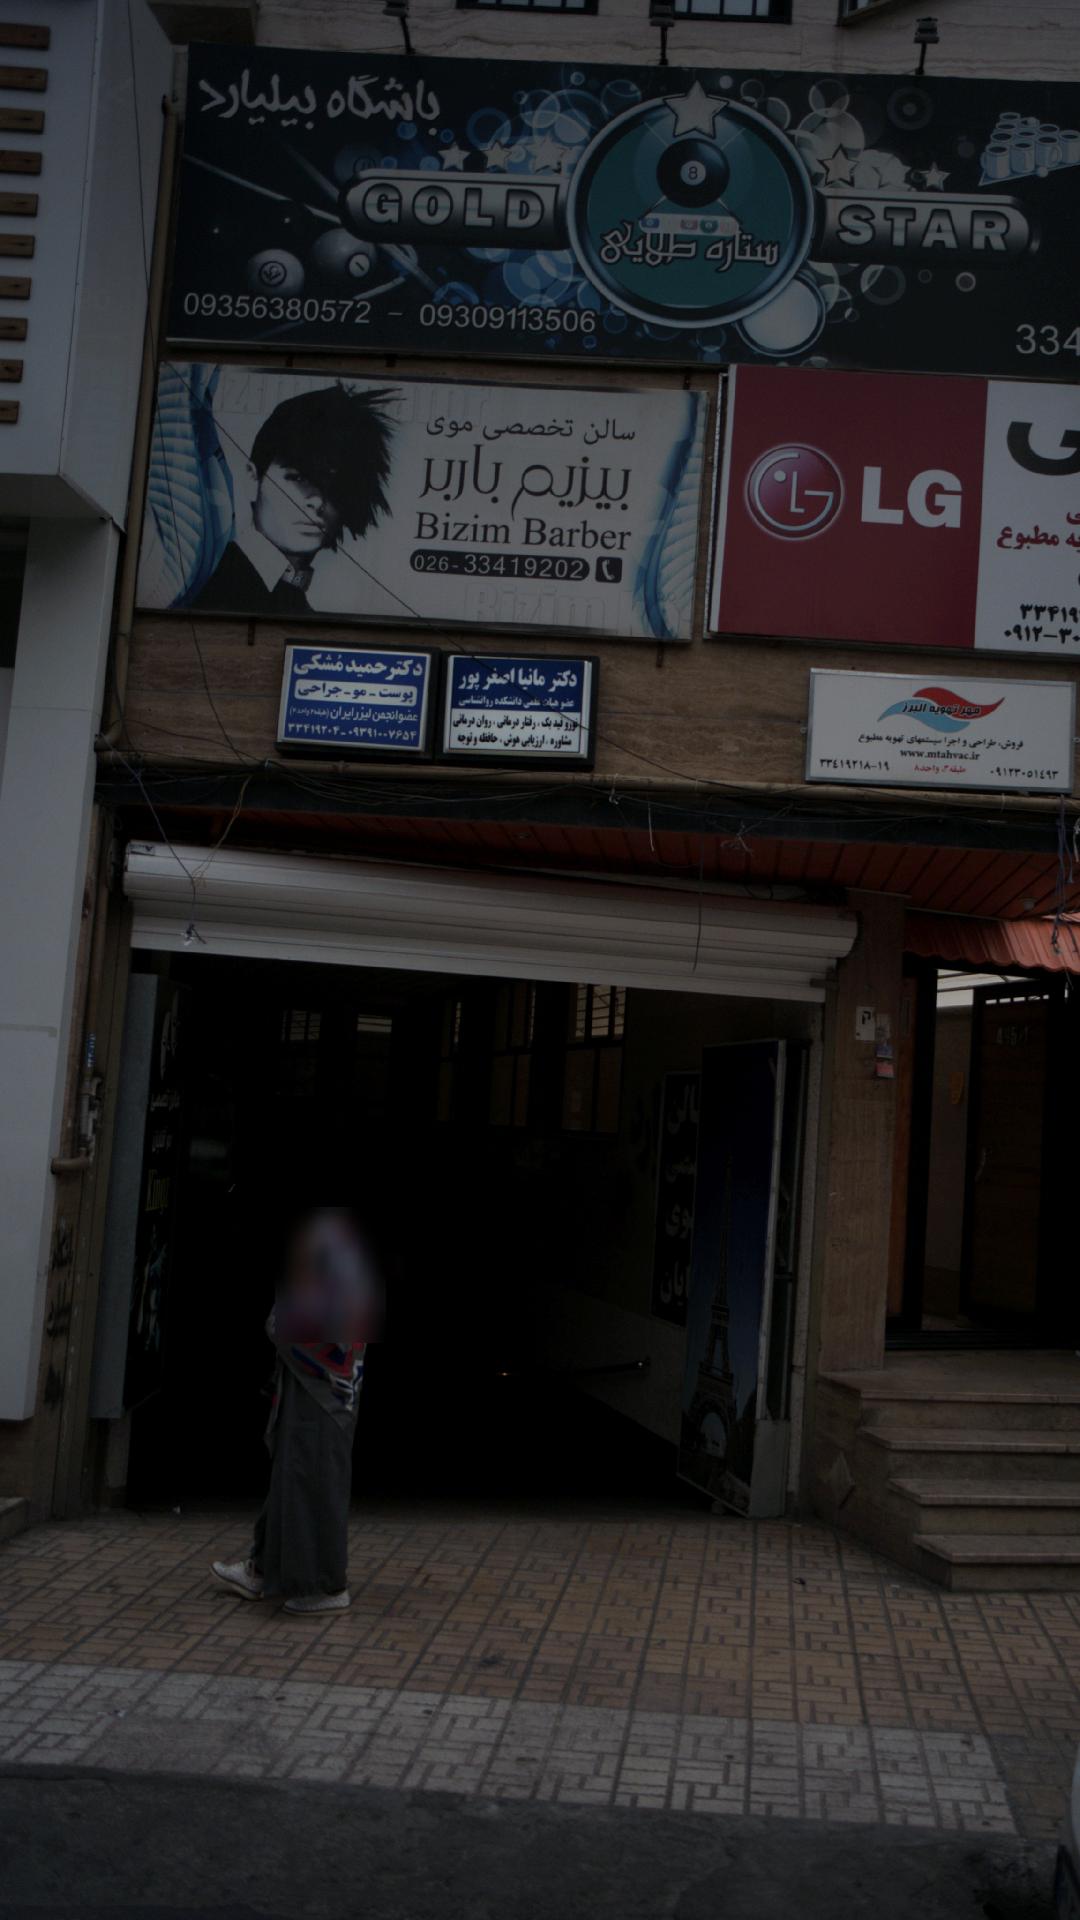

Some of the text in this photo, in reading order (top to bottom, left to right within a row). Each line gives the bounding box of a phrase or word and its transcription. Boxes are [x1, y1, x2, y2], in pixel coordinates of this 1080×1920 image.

[199, 68, 441, 136] باشگاه بیلیارد
[362, 183, 545, 229] GOLD
[836, 204, 1011, 252] STAR
[600, 219, 779, 272] ستاره طلایی
[183, 291, 371, 324] 09356380572
[419, 303, 596, 333] 09309113506
[426, 416, 636, 444] سالن تخصصی موی
[419, 444, 632, 521] بیزیم باربر
[860, 466, 963, 529] LG
[414, 511, 632, 551] Bizim Barber
[997, 525, 1060, 549] مطبوع
[413, 553, 585, 580] 026-33419202
[1020, 603, 1080, 624] ۳۳۴۱۹
[345, 659, 387, 678] حمید
[385, 659, 423, 680] دکتر
[457, 671, 480, 691] پور
[547, 669, 578, 692] دکتر
[298, 682, 342, 698] جراحی
[353, 689, 367, 699] مو
[395, 708, 419, 724] عضو
